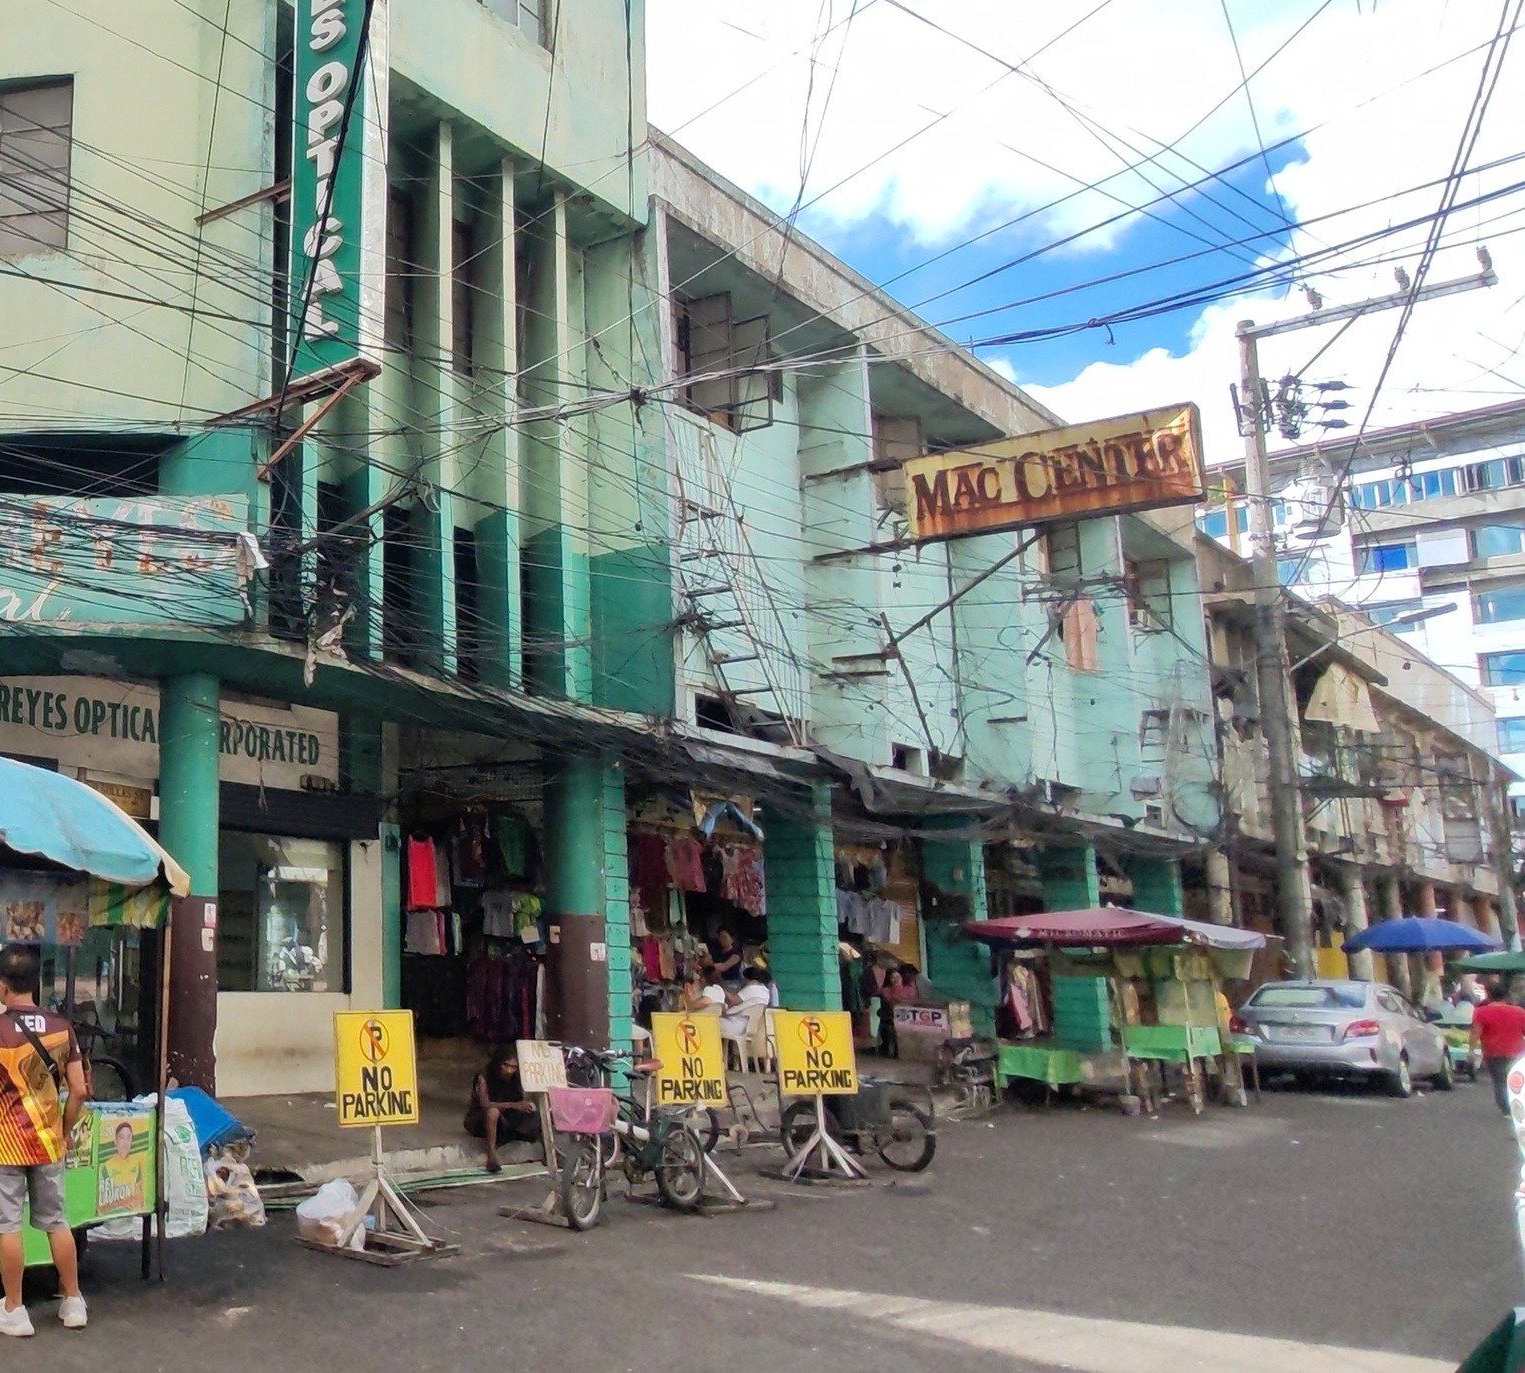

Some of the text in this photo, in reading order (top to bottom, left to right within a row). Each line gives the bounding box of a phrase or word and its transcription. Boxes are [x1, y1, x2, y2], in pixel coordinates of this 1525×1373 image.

[301, 61, 348, 342] OPTICAL
[912, 430, 1190, 521] MAC CENTER
[74, 696, 158, 744] OPTICA
[1038, 928, 1127, 939] MICROMATIC
[908, 1009, 942, 1022] TGP
[681, 1057, 704, 1078] NO
[806, 1048, 834, 1069] NO
[361, 1065, 392, 1093] NO
[523, 1060, 565, 1085] PARKING
[784, 1069, 852, 1089] PARKING
[661, 1079, 723, 1101] PARKING
[343, 1090, 413, 1119] PARKING
